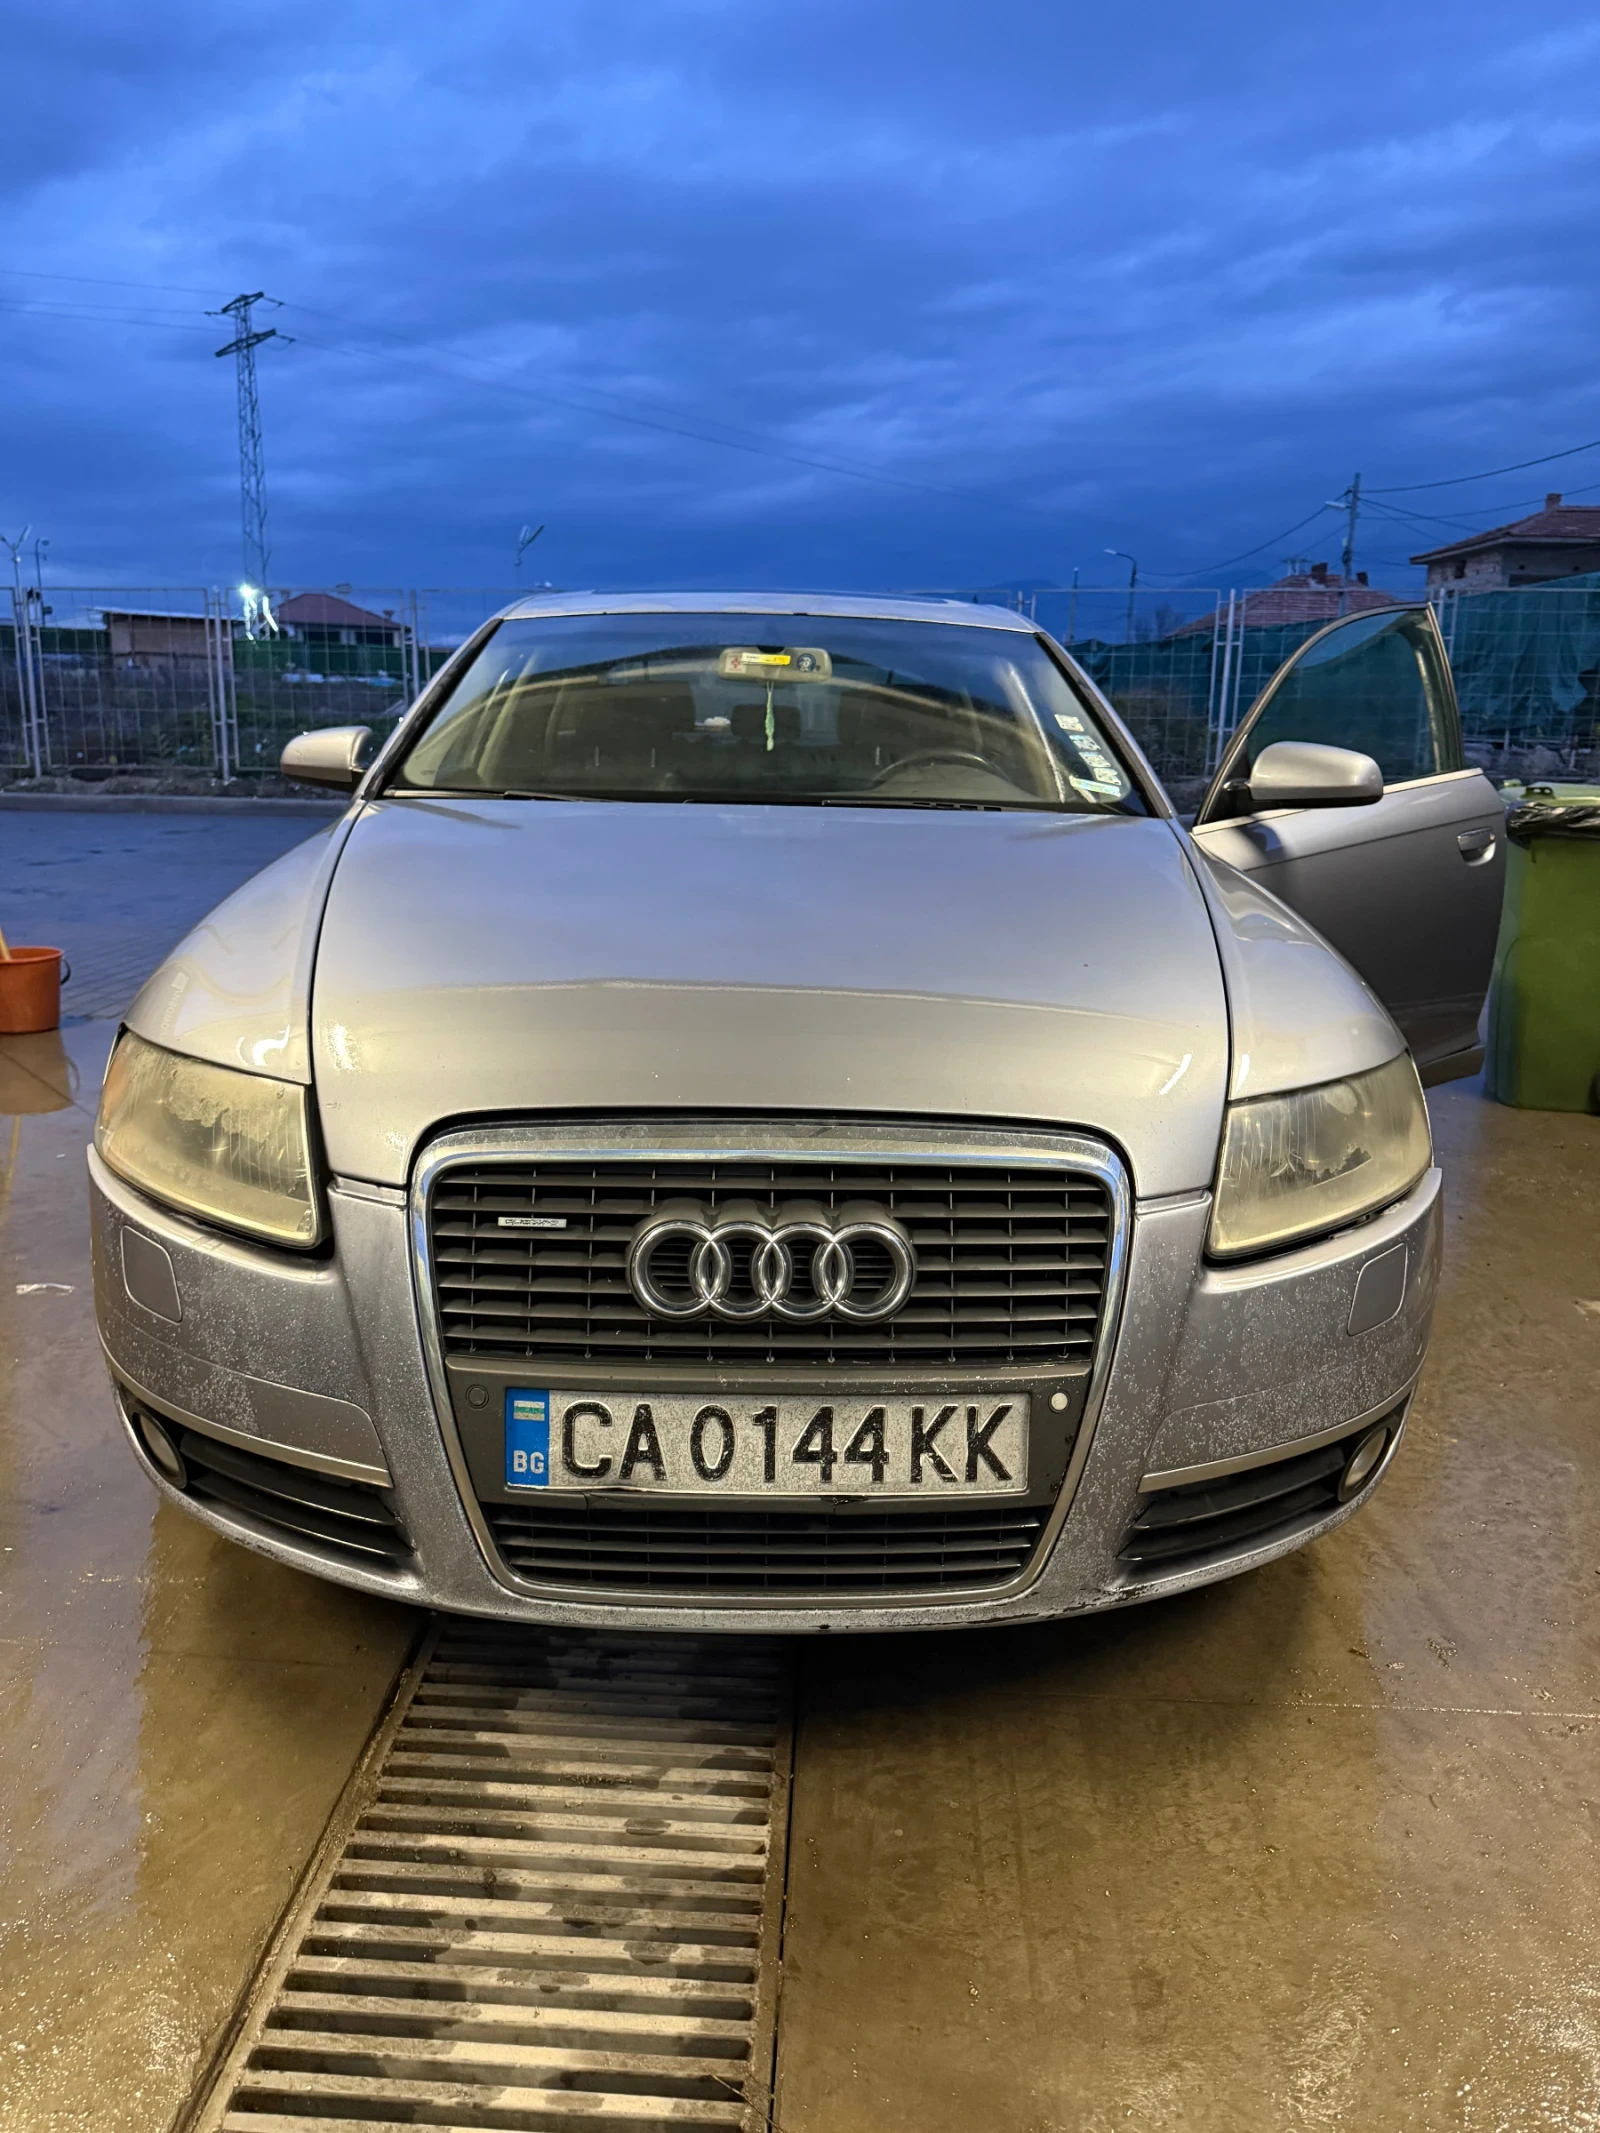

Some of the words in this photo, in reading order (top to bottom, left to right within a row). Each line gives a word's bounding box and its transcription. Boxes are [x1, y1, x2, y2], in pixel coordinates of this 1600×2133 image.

[512, 1450, 545, 1475] BG
[561, 1399, 667, 1482] CA
[688, 1402, 890, 1484] 0144
[908, 1402, 1015, 1482] KK
